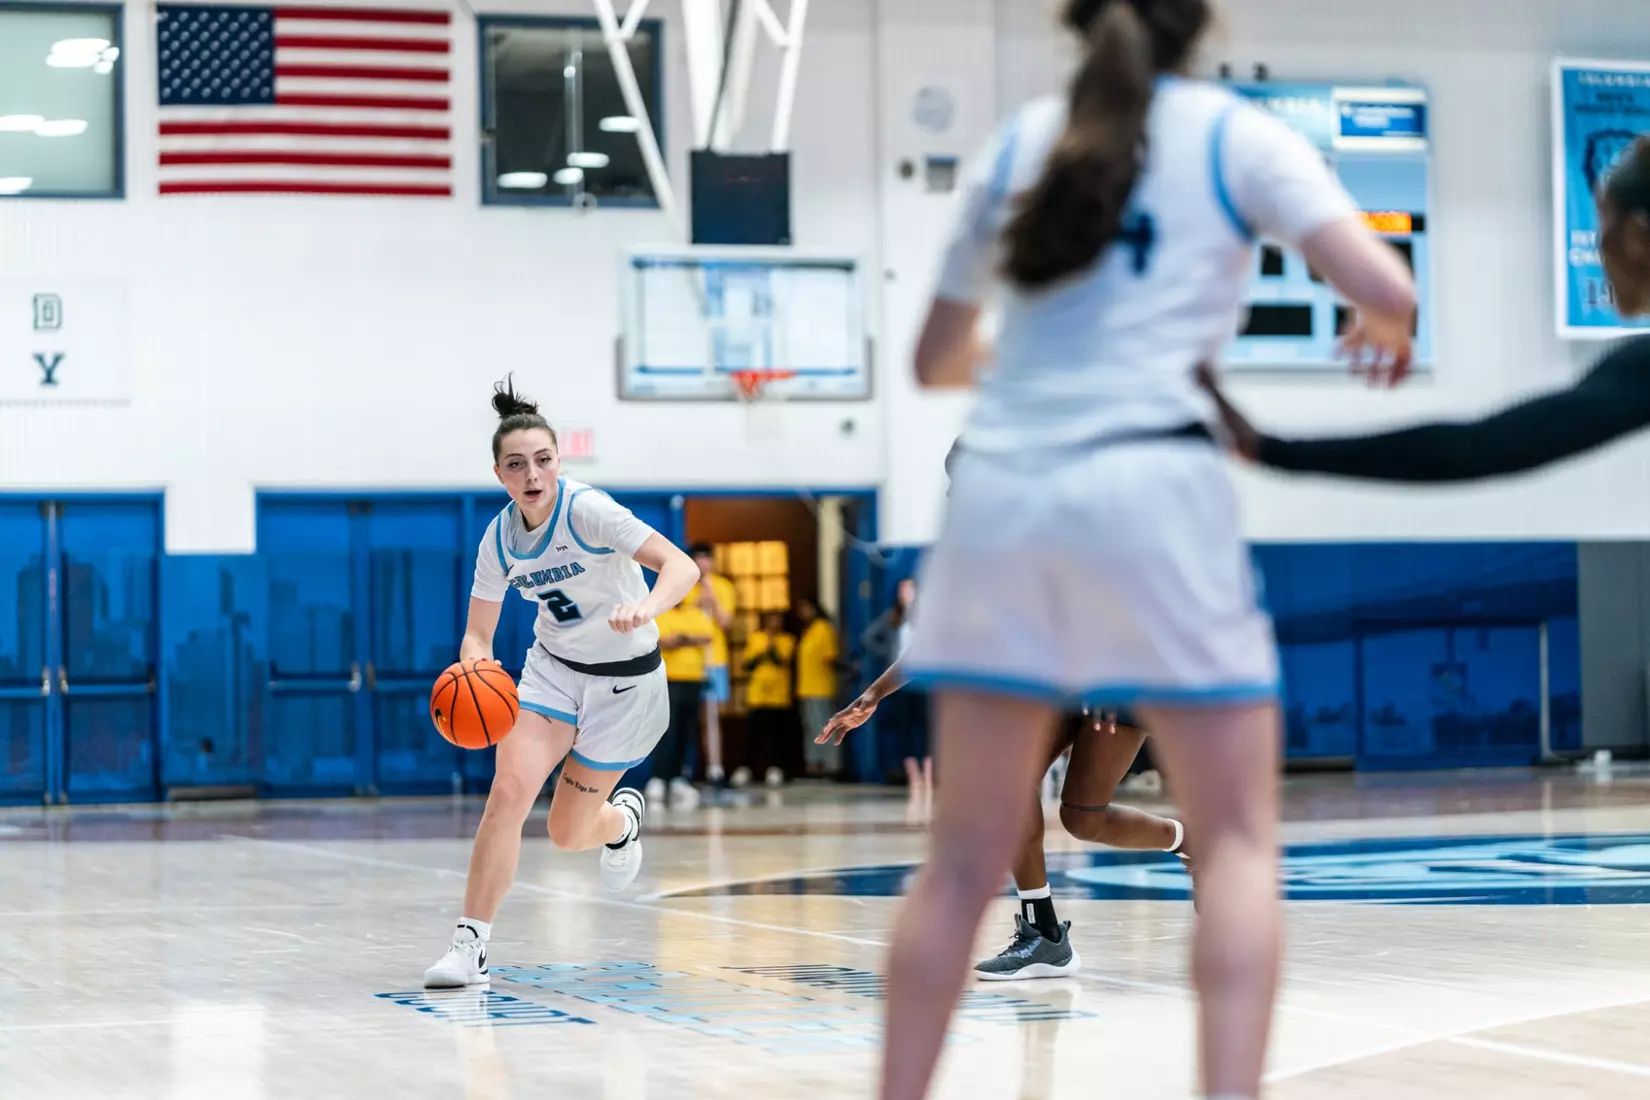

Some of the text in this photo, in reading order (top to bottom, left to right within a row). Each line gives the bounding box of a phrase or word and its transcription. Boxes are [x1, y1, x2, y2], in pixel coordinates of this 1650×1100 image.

[33, 293, 62, 331] D
[33, 352, 65, 387] Y
[536, 588, 584, 624] 2
